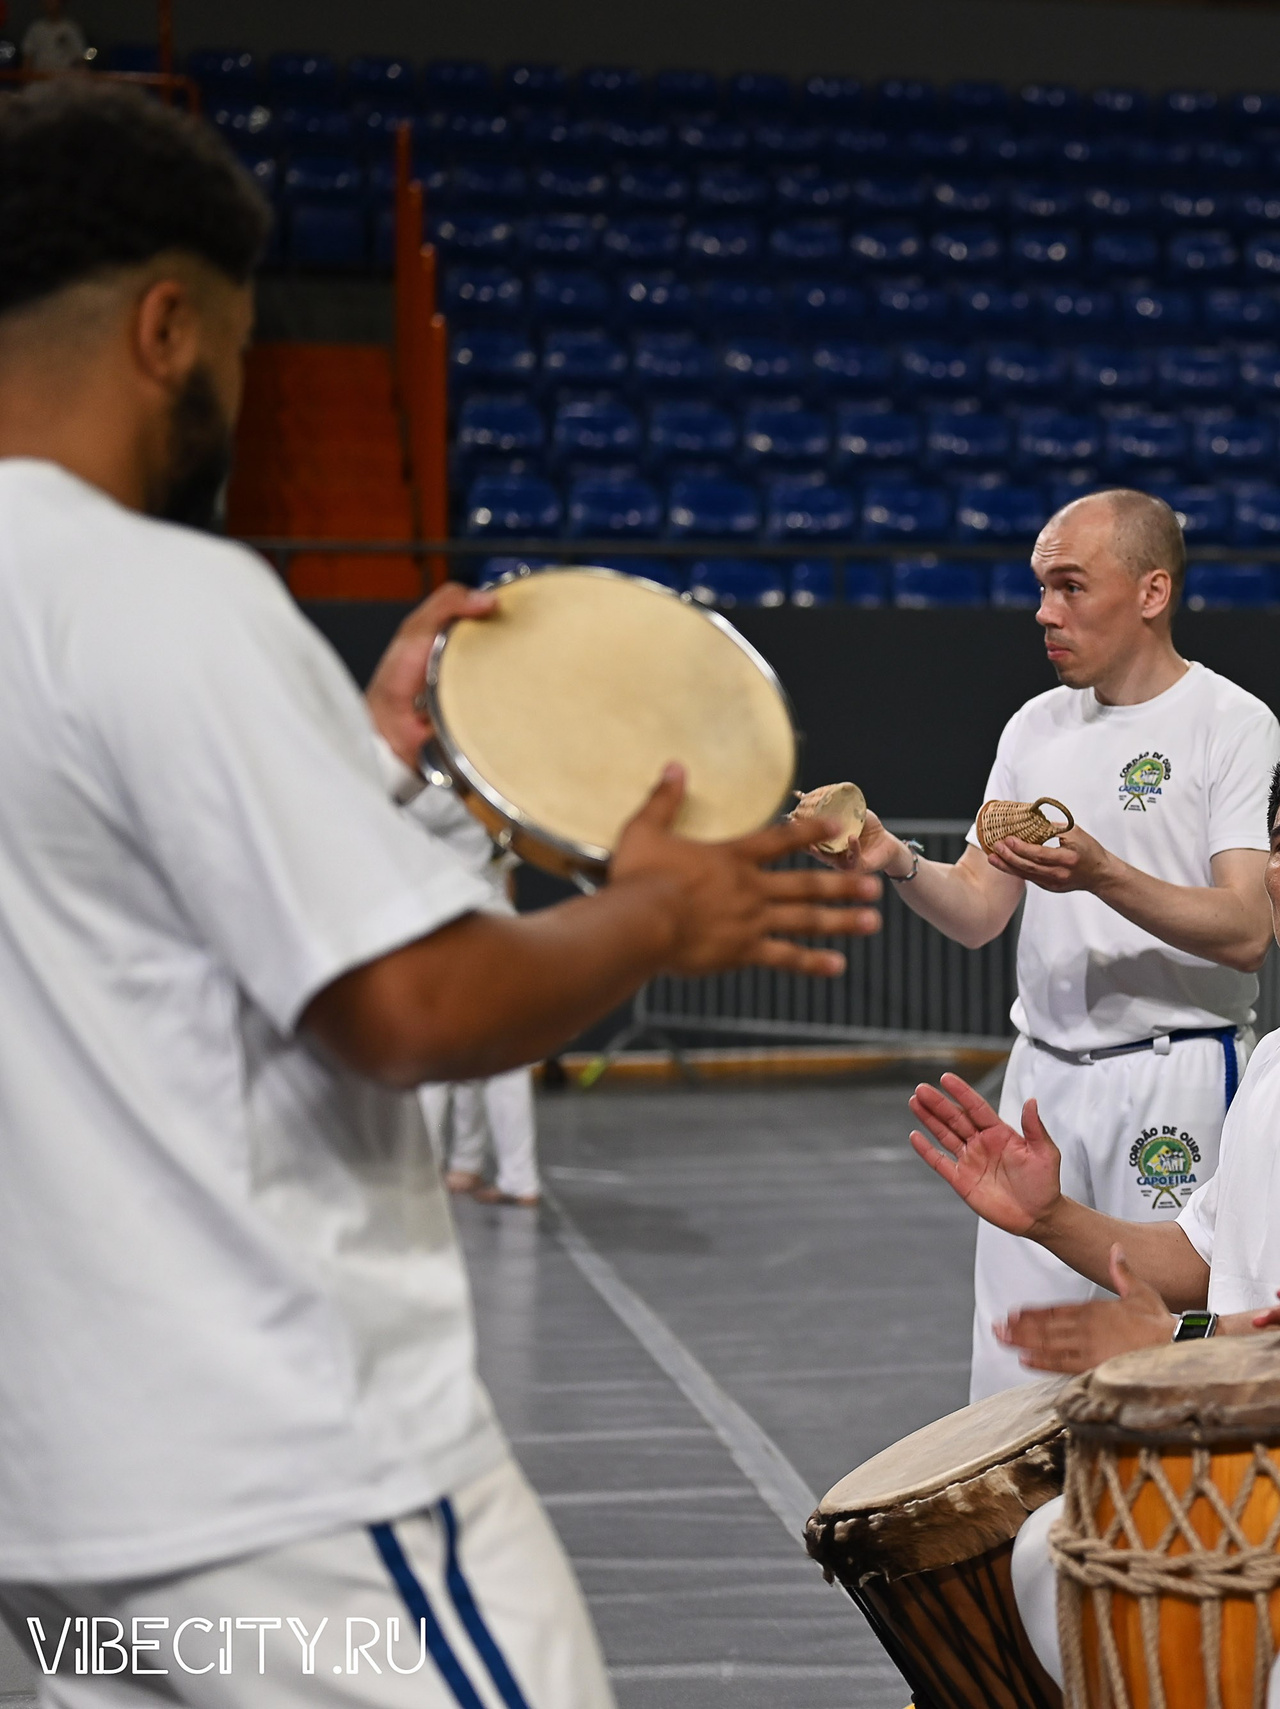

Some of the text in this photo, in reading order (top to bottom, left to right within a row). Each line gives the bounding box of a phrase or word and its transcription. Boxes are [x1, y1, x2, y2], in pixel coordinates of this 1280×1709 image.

[1118, 785, 1162, 795] CAPOEIRA
[1162, 1125, 1178, 1137] DE
[1180, 1132, 1202, 1163] OURO
[1136, 1174, 1198, 1186] CAPOEIRA
